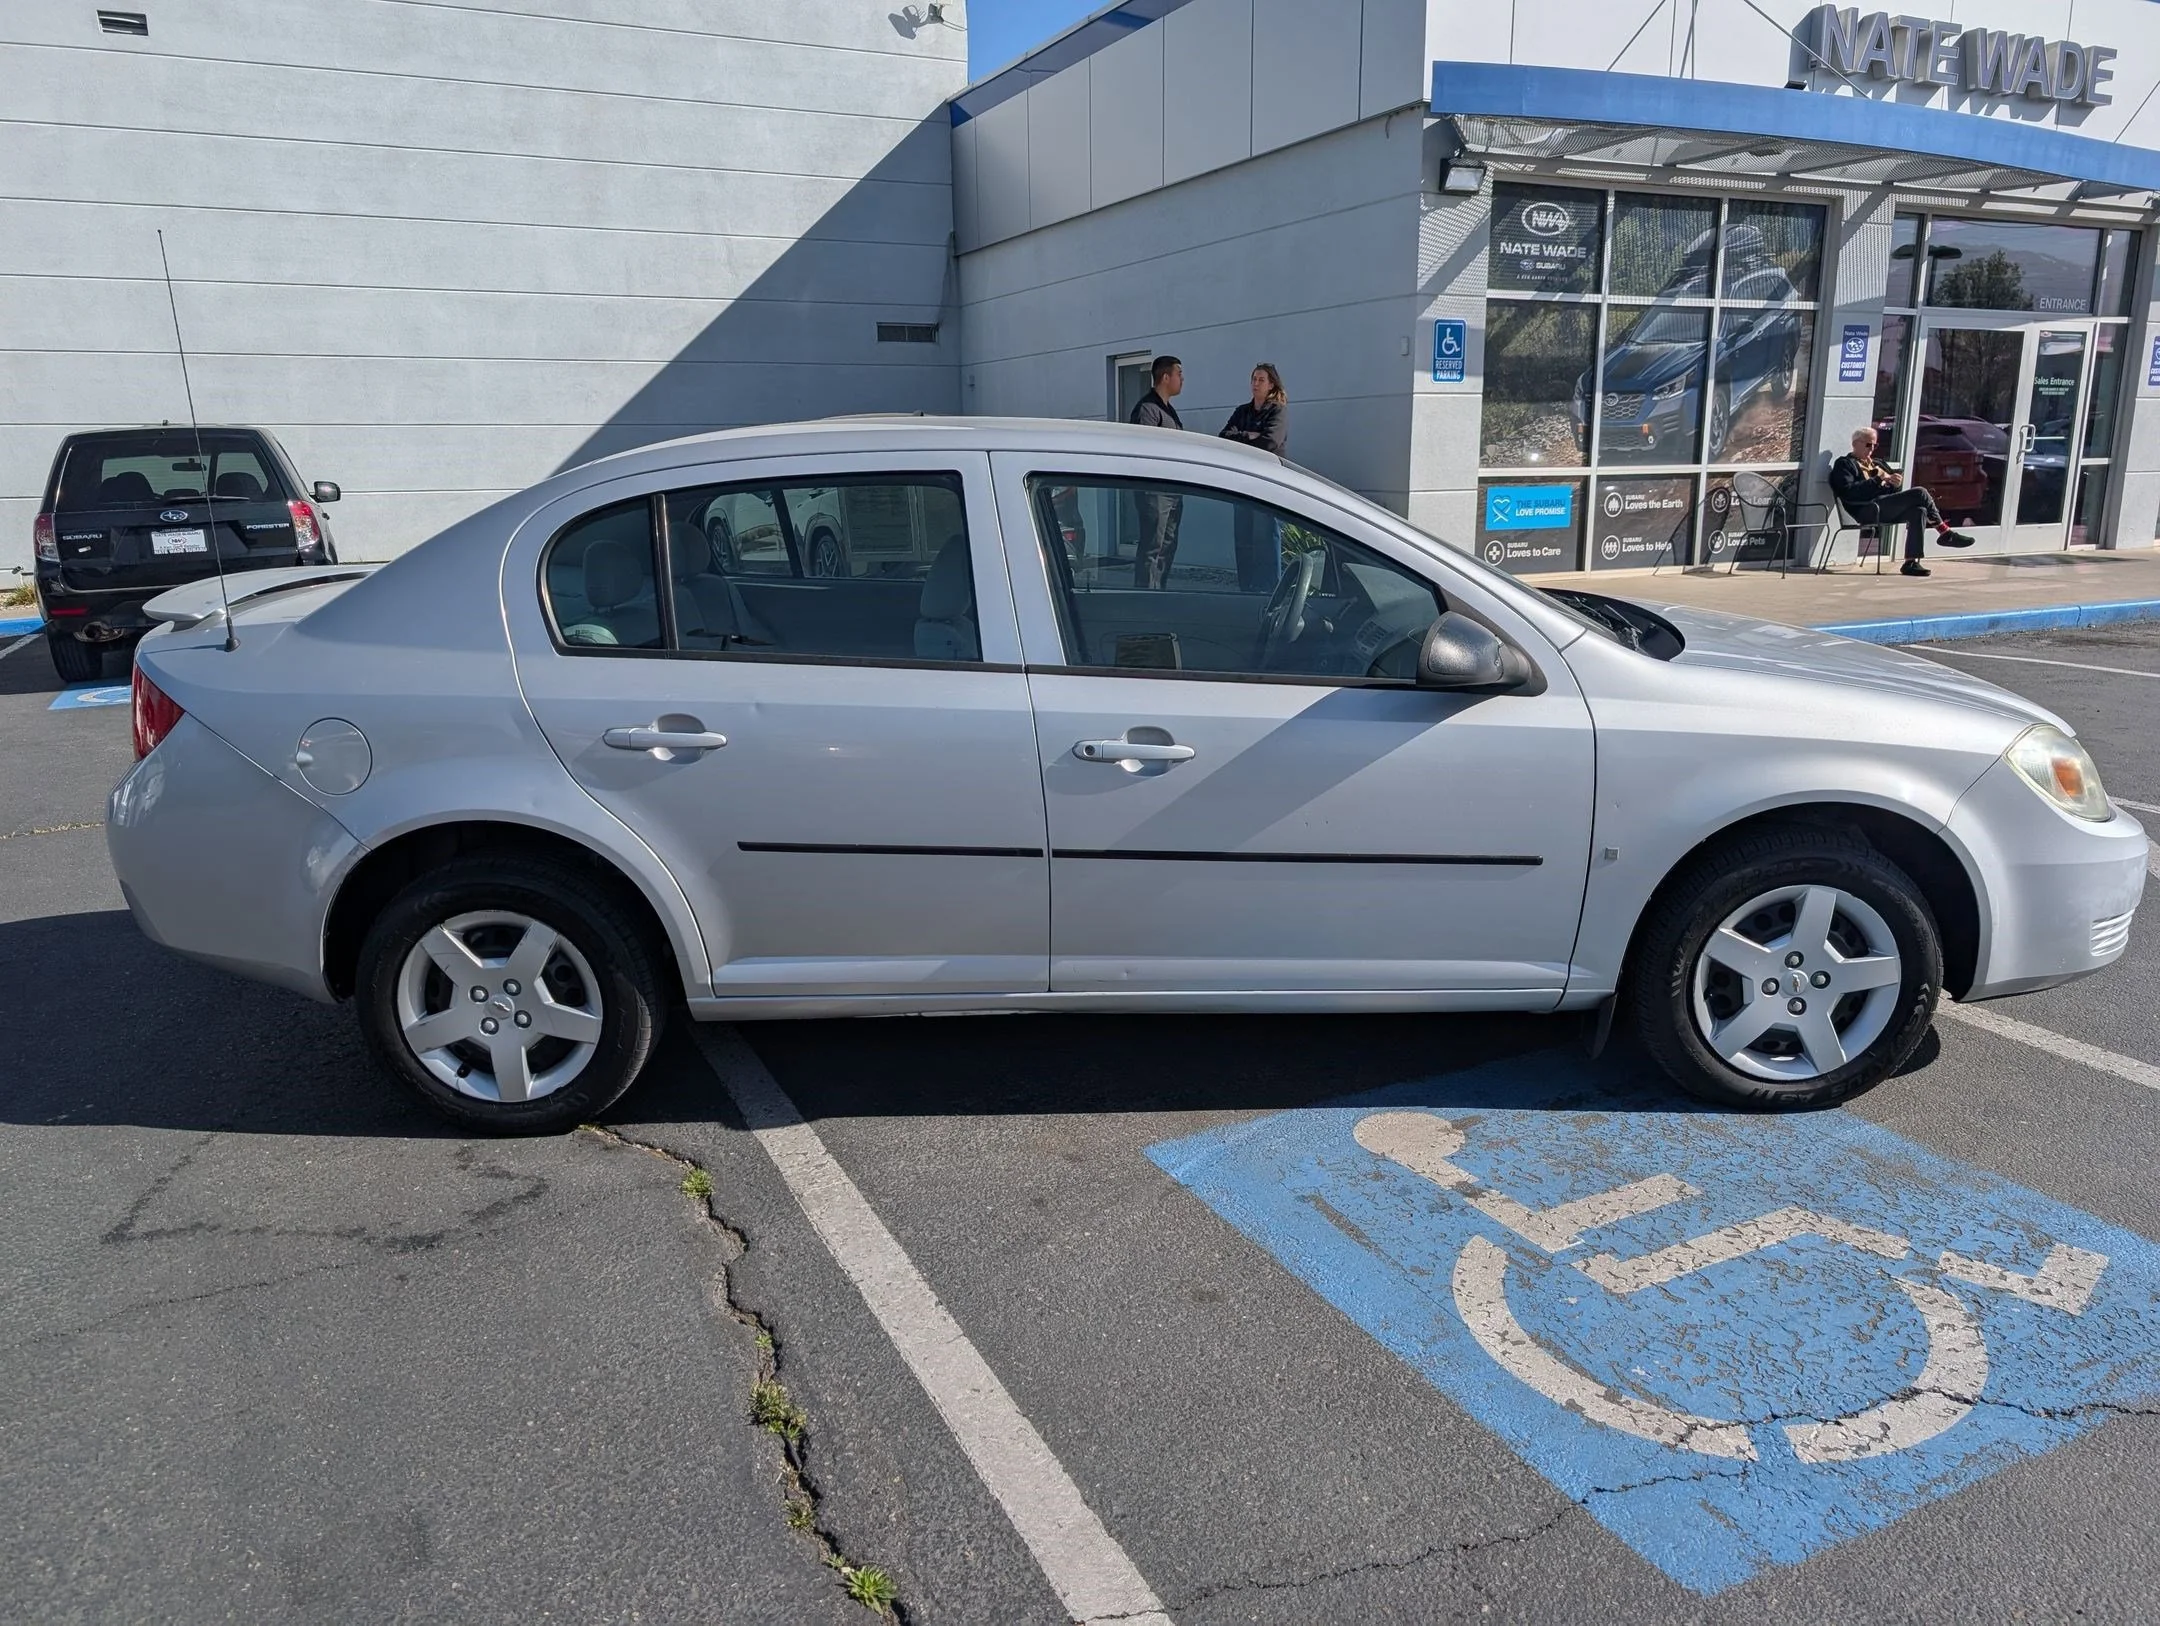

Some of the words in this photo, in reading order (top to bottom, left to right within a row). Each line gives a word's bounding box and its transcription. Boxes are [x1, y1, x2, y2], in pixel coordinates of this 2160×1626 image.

[1819, 3, 1963, 87] NATE
[1974, 27, 2118, 106] WADE
[1500, 242, 1540, 256] NATE
[1542, 244, 1587, 259] WADE
[1536, 262, 1566, 271] SUBARU
[2039, 297, 2087, 311] ENTRANCE
[1435, 360, 1463, 370] RESERVED
[1841, 361, 1866, 369] CUSTOMER
[1436, 370, 1461, 380] PARKING
[1841, 370, 1863, 378] PARKING
[2034, 376, 2049, 385] Sales
[2050, 377, 2075, 386] Entrance
[1515, 500, 1532, 508] THE
[1533, 499, 1566, 508] SUBARU
[1625, 500, 1648, 510] Loves
[1649, 499, 1662, 509] the
[1662, 499, 1684, 509] Earth
[1515, 507, 1533, 517] LOVE
[1534, 506, 1567, 516] PROMISE
[246, 522, 290, 530] FORESTER
[62, 533, 103, 541] SUBARU
[1750, 536, 1766, 546] Pets
[1507, 541, 1529, 549] SUBARU
[1622, 543, 1645, 552] Loves
[1645, 542, 1654, 551] to
[1654, 541, 1672, 552] Help
[1506, 549, 1532, 558] Loves
[1532, 547, 1541, 557] to
[1541, 546, 1562, 557] Care
